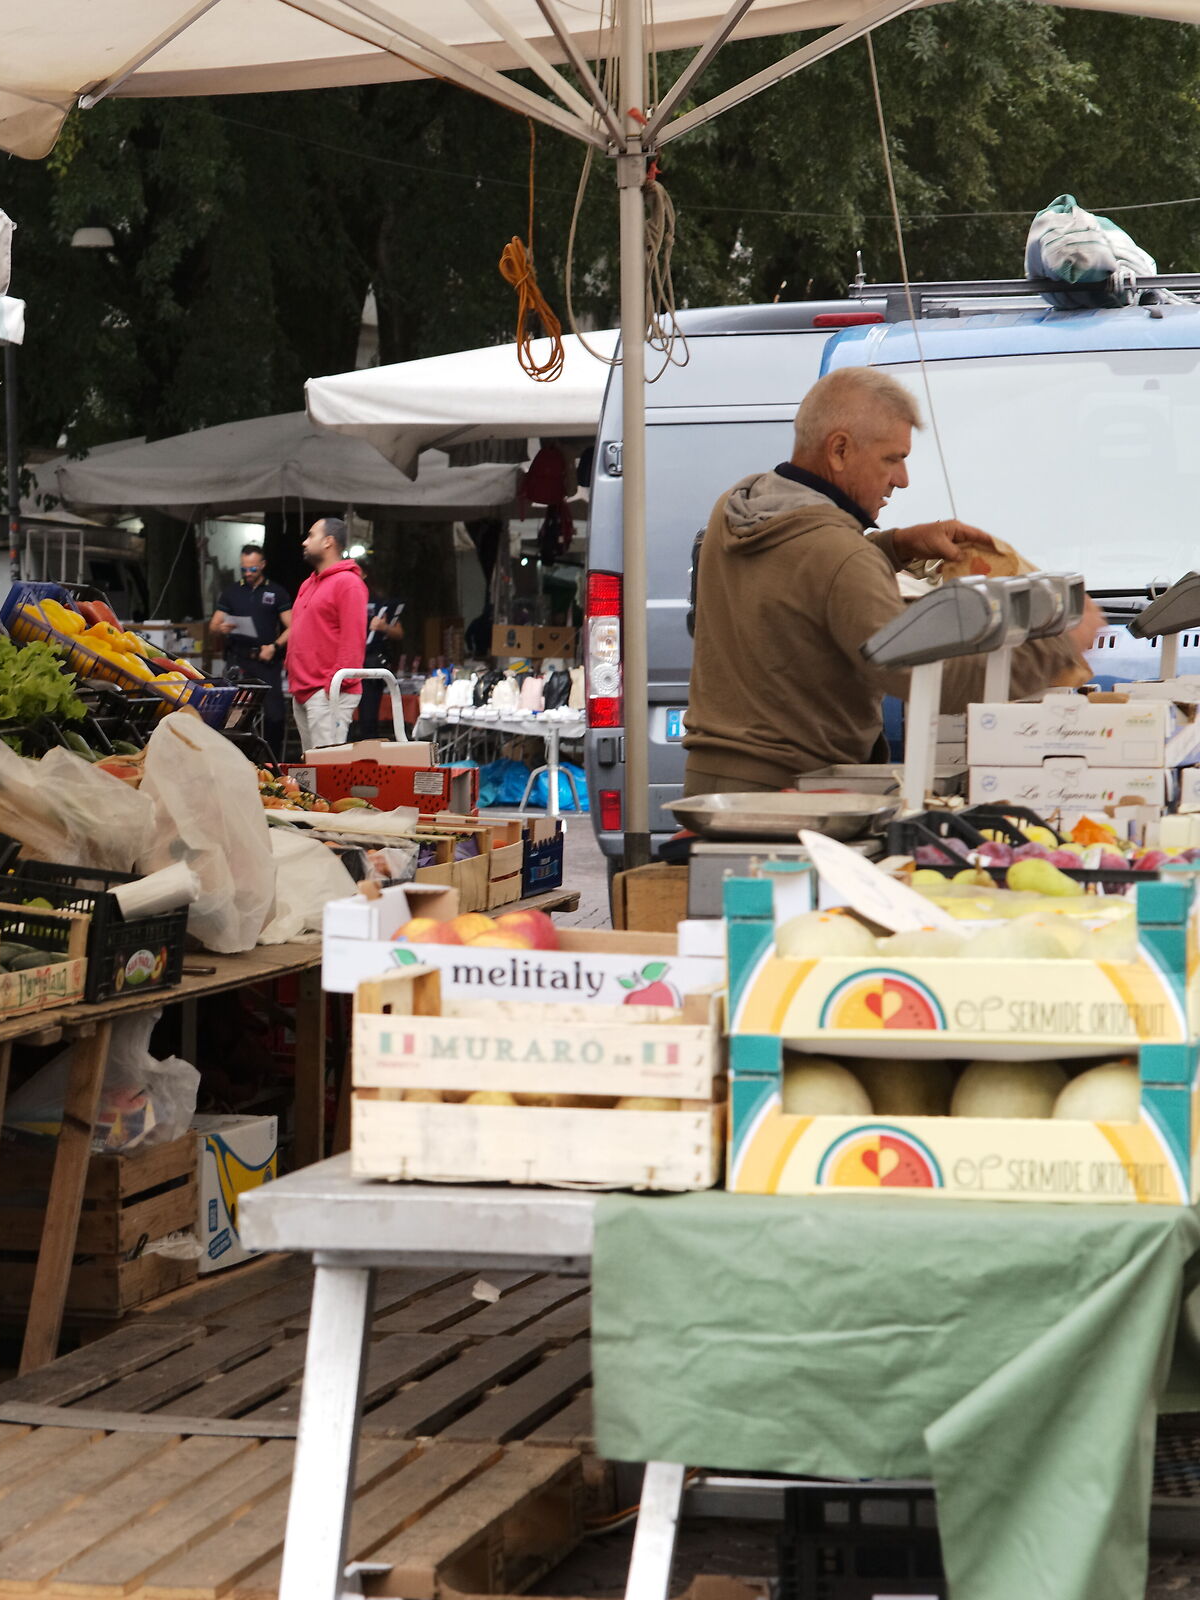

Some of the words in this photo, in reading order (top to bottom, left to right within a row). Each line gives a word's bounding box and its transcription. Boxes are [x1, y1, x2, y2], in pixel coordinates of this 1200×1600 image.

[451, 958, 606, 997] melitaly
[1008, 1001, 1083, 1033] SERMIDE
[430, 1035, 606, 1065] MURARO
[1007, 1160, 1083, 1193] SERMIDE
